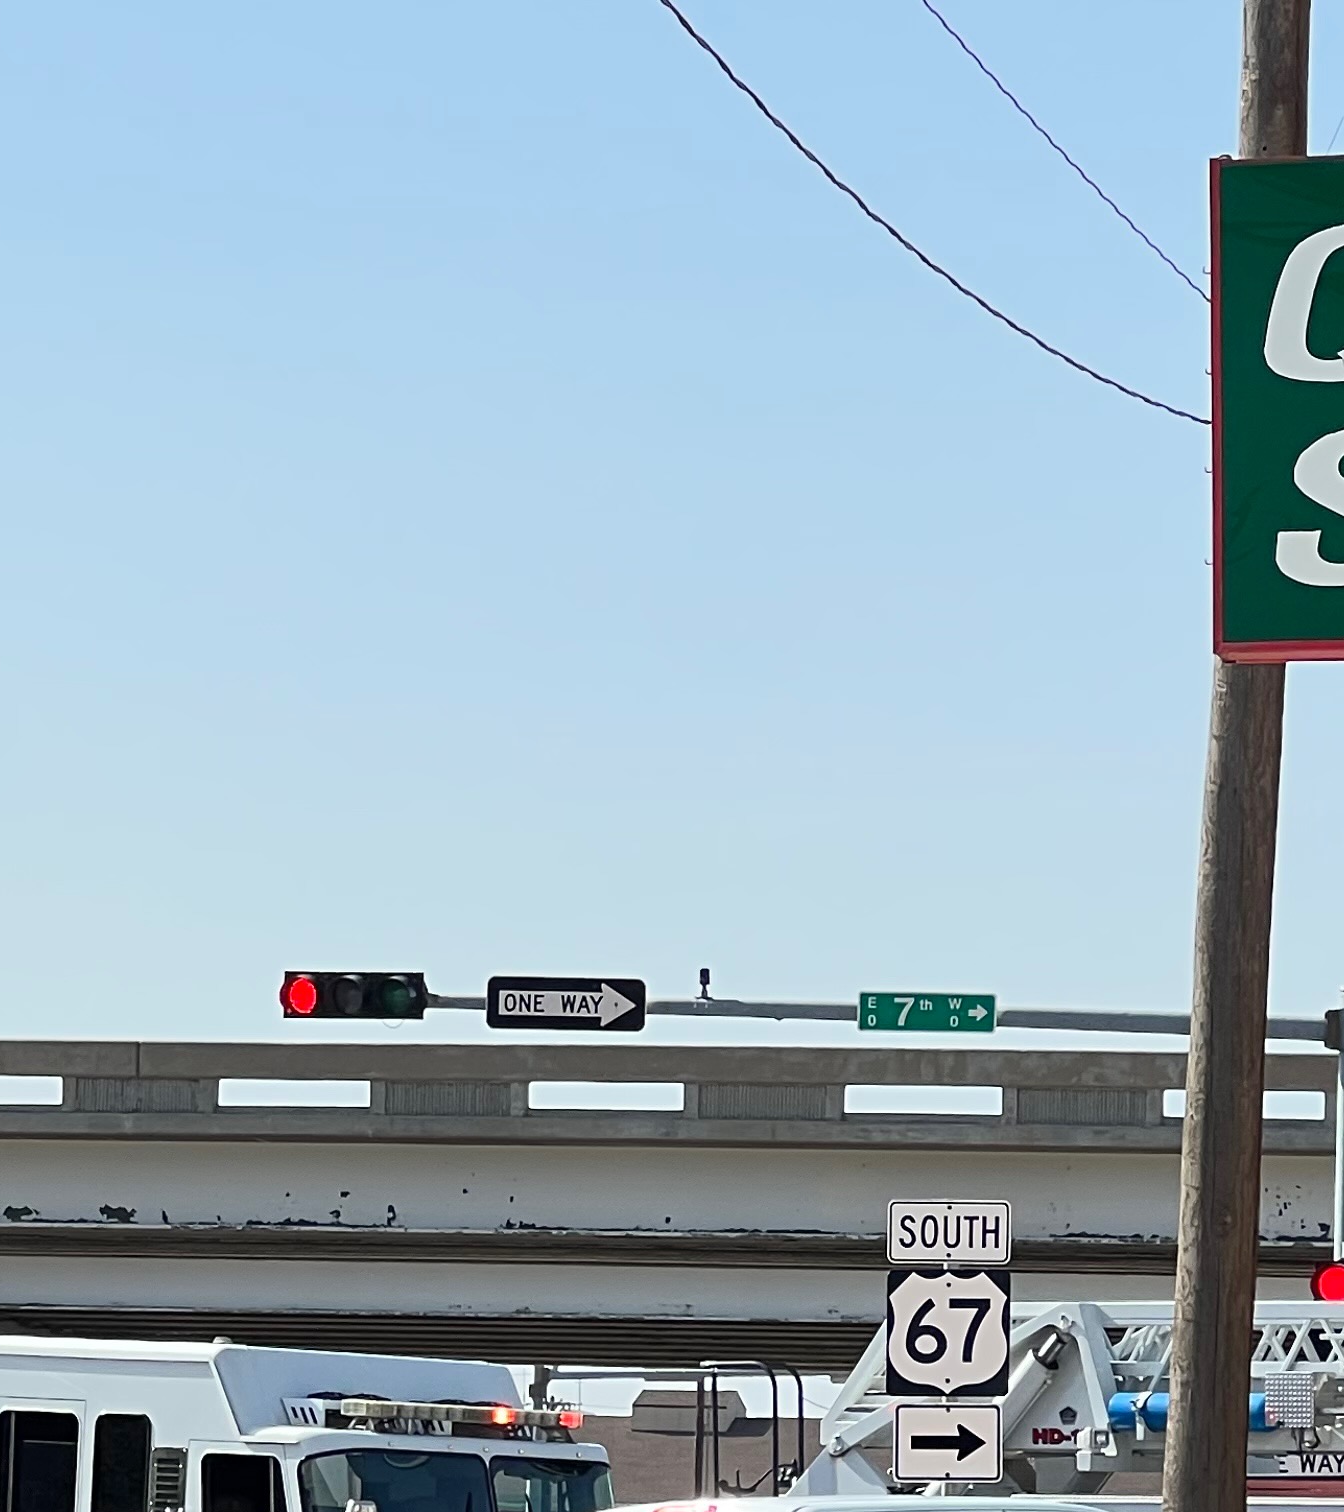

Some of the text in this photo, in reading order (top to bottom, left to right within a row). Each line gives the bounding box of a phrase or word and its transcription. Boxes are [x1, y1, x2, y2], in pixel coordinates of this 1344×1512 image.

[504, 994, 604, 1014] ONE WAY
[868, 997, 877, 1008] E
[948, 998, 962, 1010] W
[899, 1215, 1000, 1249] SOUTH
[906, 1298, 991, 1364] 67
